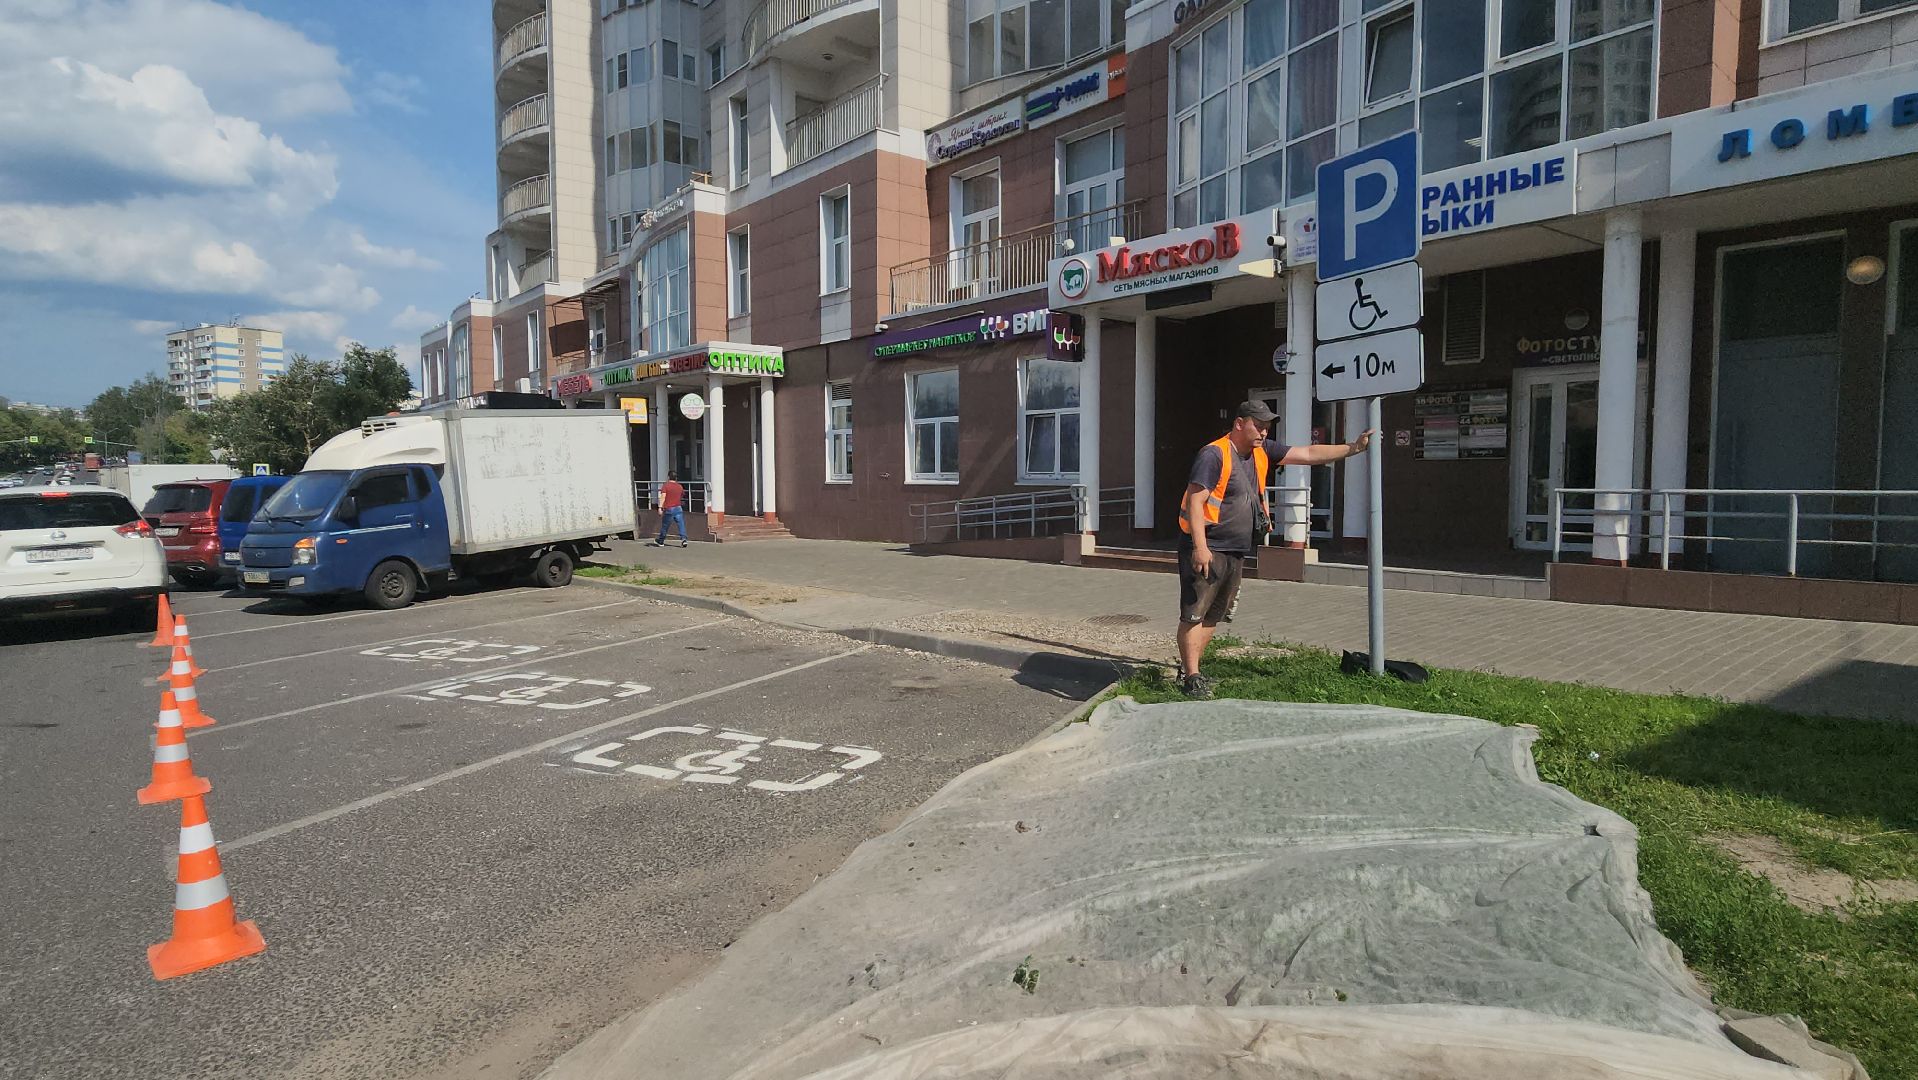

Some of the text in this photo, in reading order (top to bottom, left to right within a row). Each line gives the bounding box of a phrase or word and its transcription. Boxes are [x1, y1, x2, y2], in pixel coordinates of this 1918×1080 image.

[1422, 156, 1565, 210] РАННЫЕ
[1344, 159, 1398, 261] P
[1422, 200, 1494, 236] ЫКИ
[1113, 265, 1219, 293] СЕТЬ МЯСНЫХ МАГАЗИНОВ
[709, 351, 785, 373] ОПТИКА
[556, 373, 593, 396] МЕБЕЛЬ
